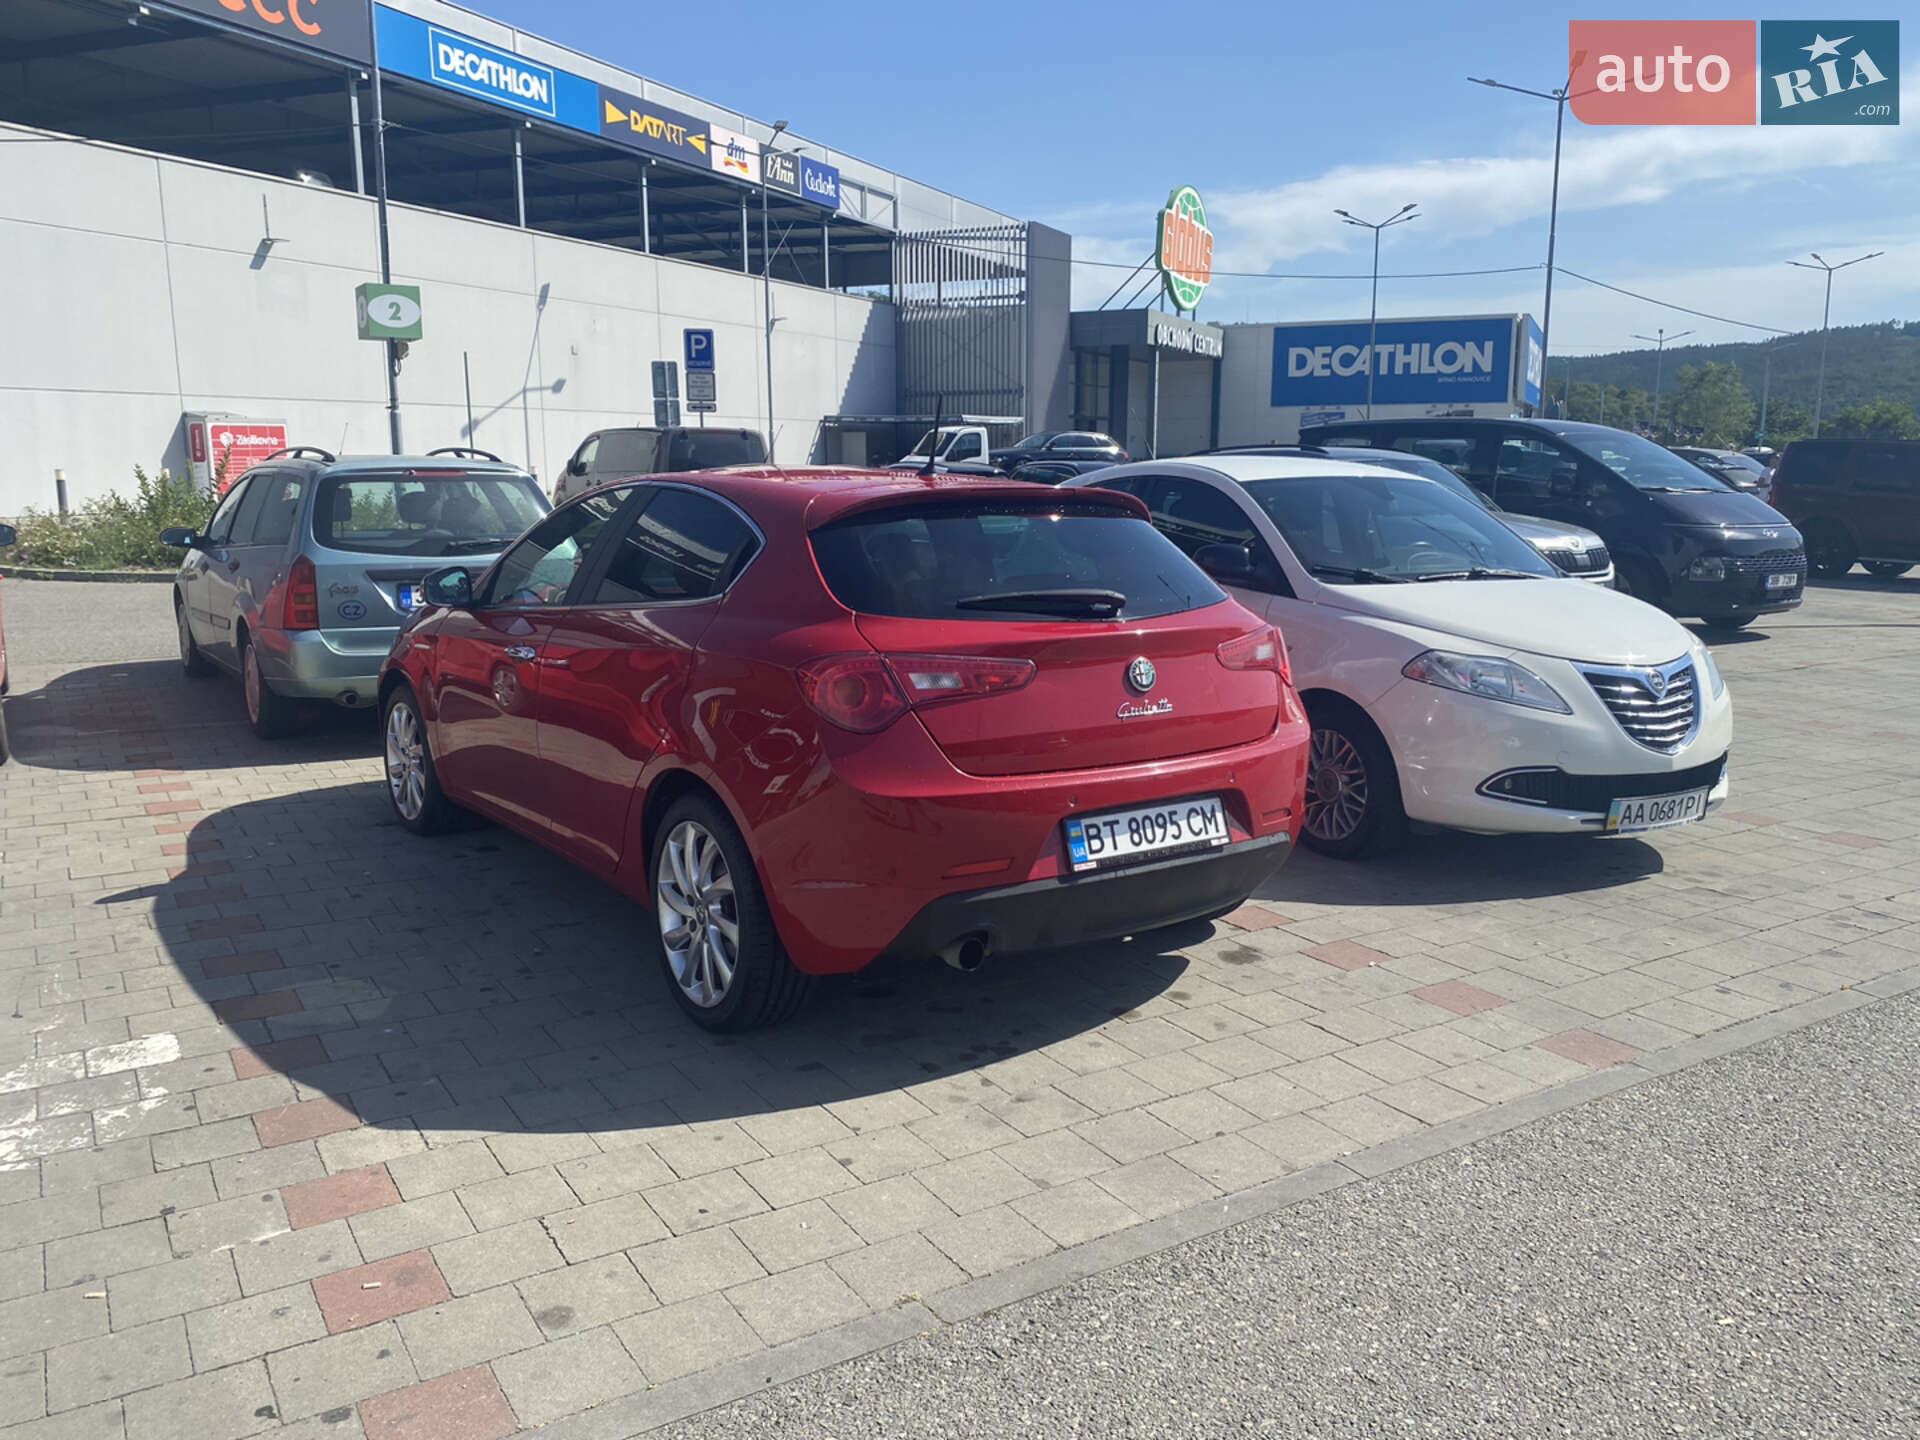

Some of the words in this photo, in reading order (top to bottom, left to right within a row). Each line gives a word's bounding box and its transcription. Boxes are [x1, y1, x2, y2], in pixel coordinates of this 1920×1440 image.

[438, 43, 548, 104] DECATHLON
[630, 109, 687, 146] DATART
[727, 137, 745, 161] dm
[388, 302, 402, 321] 2
[691, 334, 707, 358] P
[1288, 341, 1493, 377] DECATHLON
[342, 604, 361, 616] CZ
[1620, 804, 1644, 824] AA
[1085, 819, 1120, 854] BT
[1128, 810, 1182, 847] 8095
[1187, 804, 1220, 836] CM
